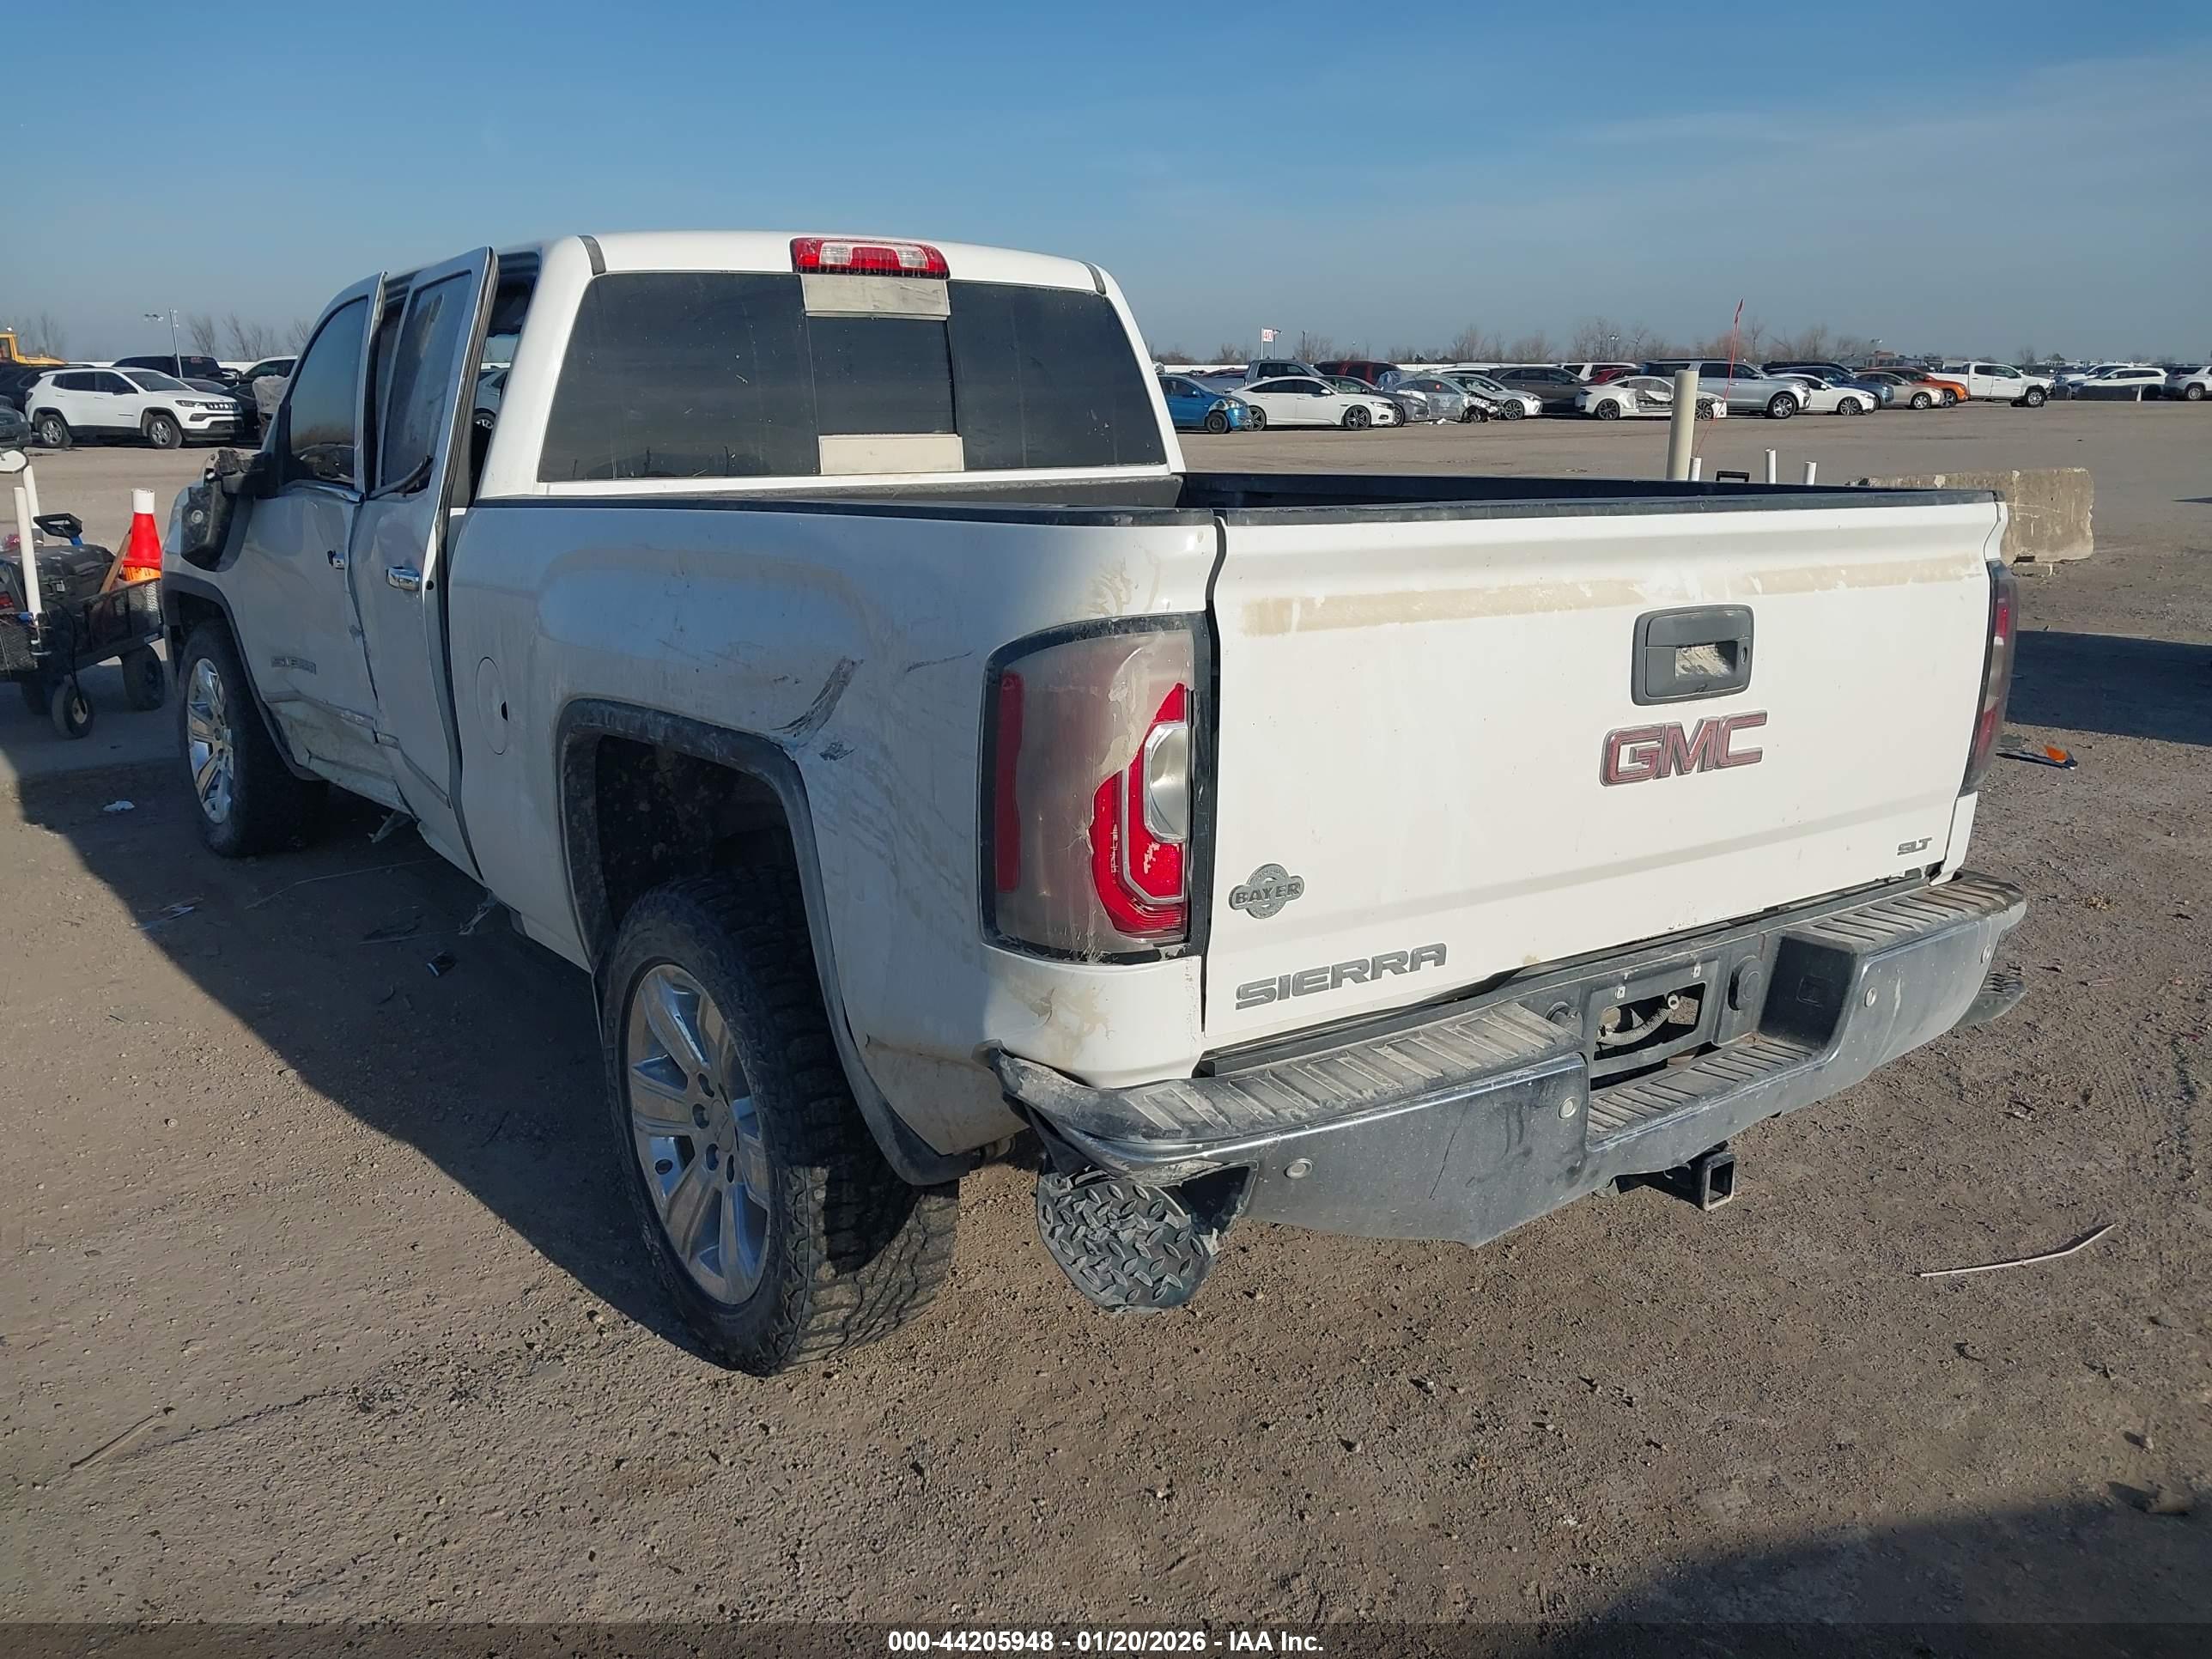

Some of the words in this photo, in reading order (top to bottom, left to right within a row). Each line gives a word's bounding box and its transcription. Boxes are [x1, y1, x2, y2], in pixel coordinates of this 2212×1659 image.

[1263, 331, 1273, 341] 40
[1600, 710, 1768, 787] GMC
[1897, 836, 1933, 856] SLT
[1235, 882, 1301, 904] BAYER
[1236, 943, 1447, 1010] SIERRA
